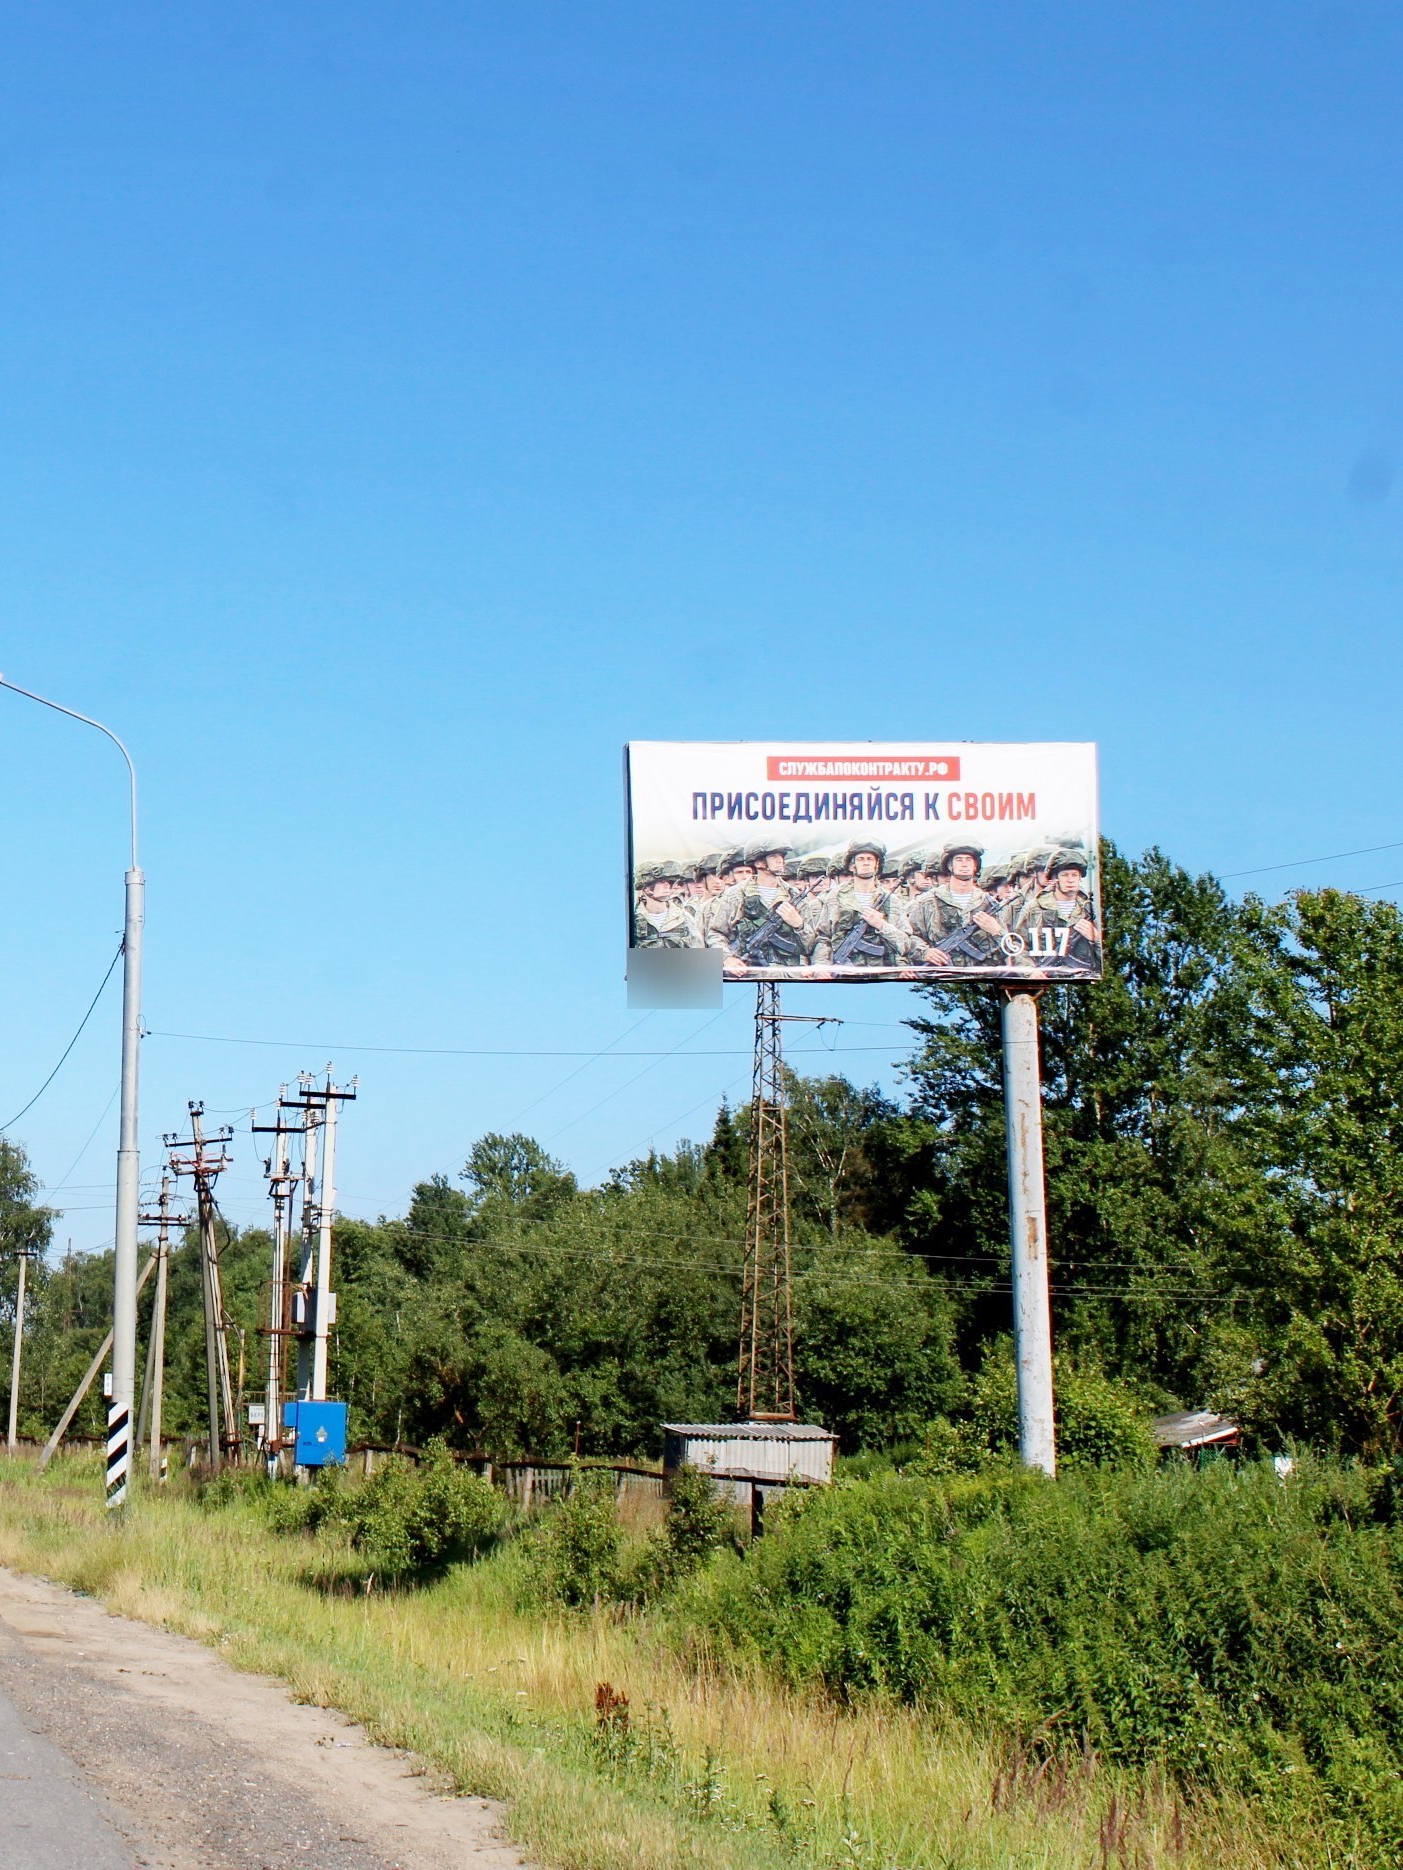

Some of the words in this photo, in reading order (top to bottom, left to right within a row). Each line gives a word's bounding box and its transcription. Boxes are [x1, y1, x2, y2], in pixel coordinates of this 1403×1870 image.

[778, 761, 948, 776] СЛУЖБАПОКОНТРАКТУ.РФ
[692, 785, 915, 823] ПРИСОЕДИНЯЙСЯ
[924, 792, 940, 821] К
[947, 791, 1037, 821] СВОИМ
[1028, 927, 1070, 957] 117
